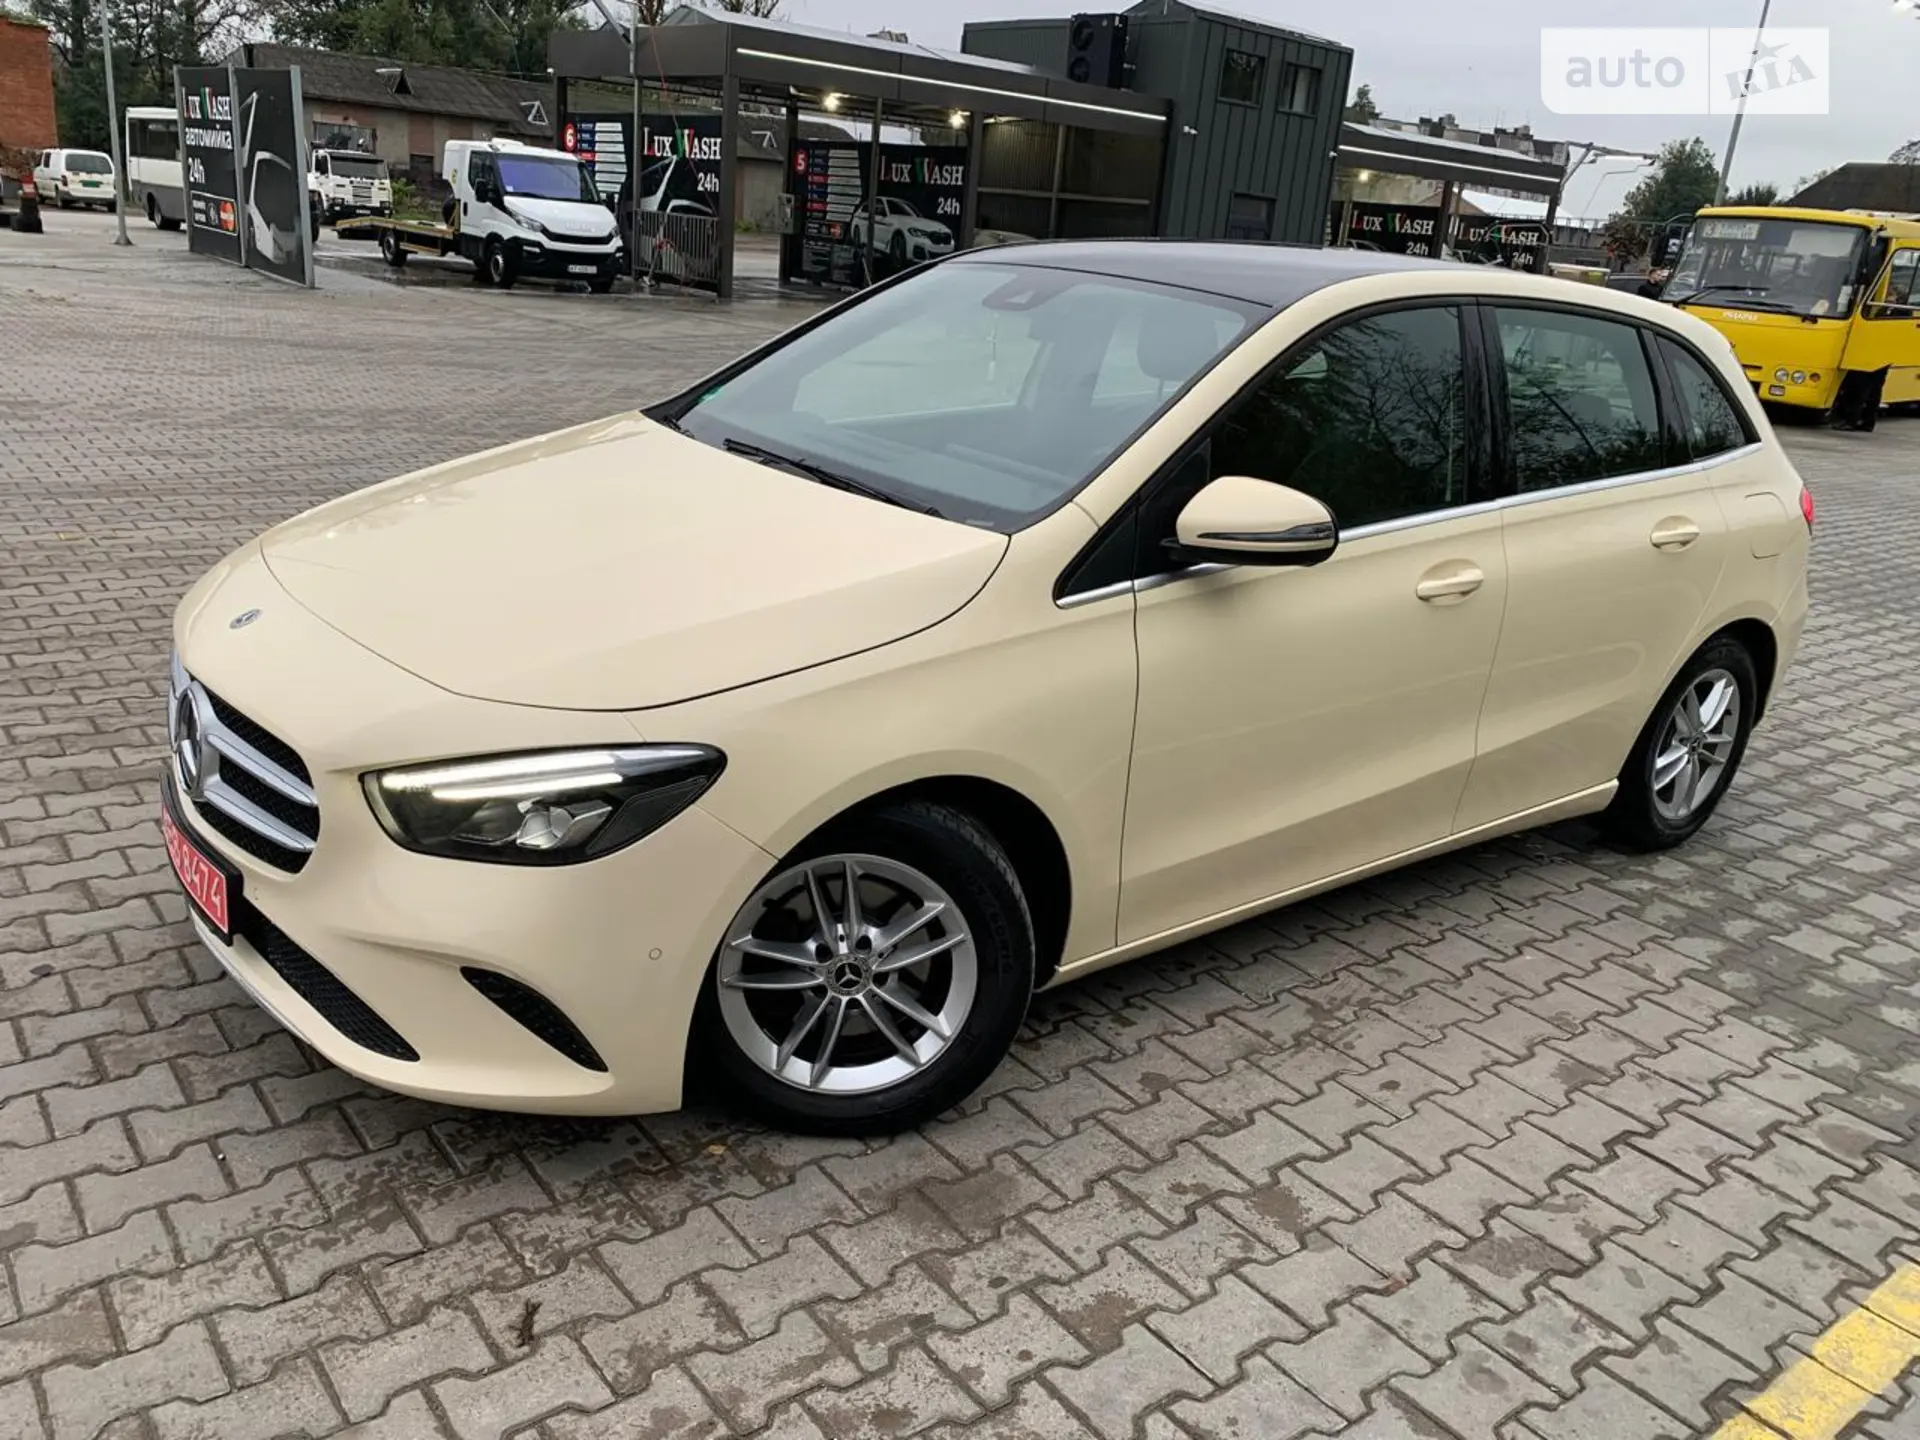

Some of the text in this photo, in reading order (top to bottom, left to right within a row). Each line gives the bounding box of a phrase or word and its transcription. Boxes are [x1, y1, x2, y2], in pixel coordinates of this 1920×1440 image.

[185, 124, 233, 150] автомийка
[566, 129, 573, 147] 6
[644, 127, 722, 160] LUX WASH
[188, 158, 205, 183] 24h
[798, 156, 805, 171] 5
[881, 156, 963, 185] LUX WASH
[698, 173, 719, 192] 24h
[937, 198, 960, 215] 24h
[1352, 210, 1434, 235] LUX WASH
[1405, 242, 1429, 256] 24h
[1512, 252, 1534, 265] 24h
